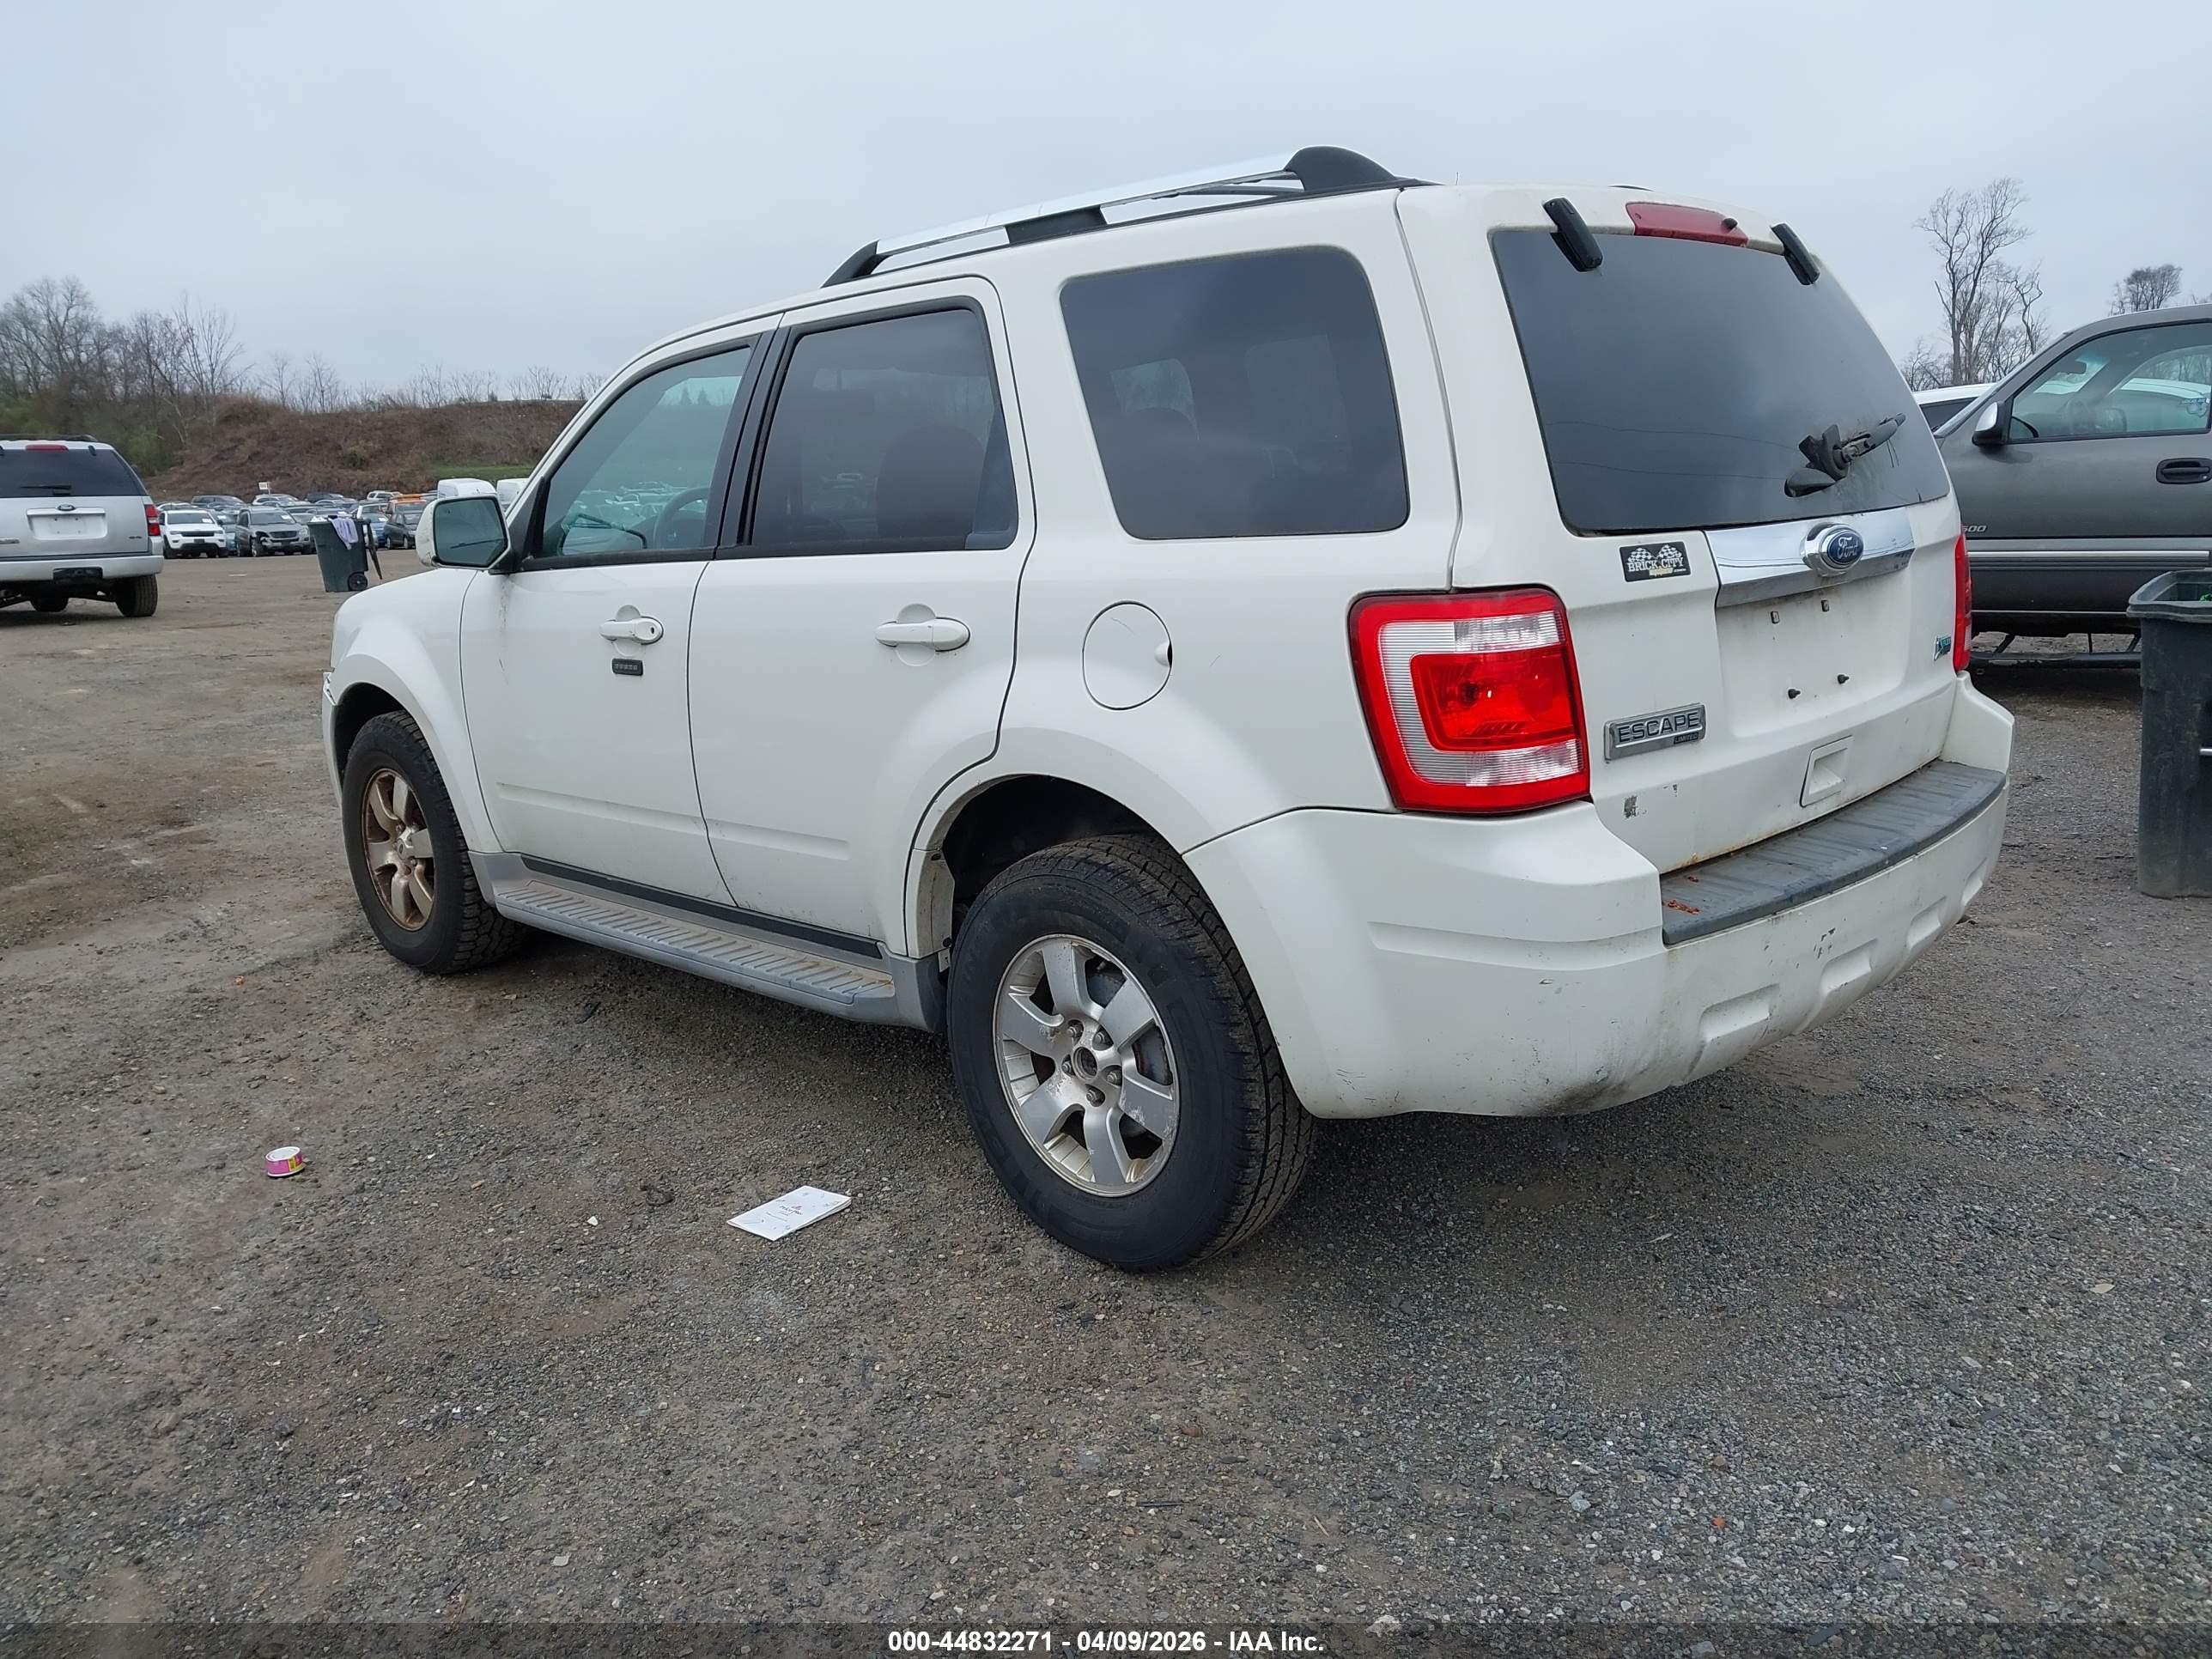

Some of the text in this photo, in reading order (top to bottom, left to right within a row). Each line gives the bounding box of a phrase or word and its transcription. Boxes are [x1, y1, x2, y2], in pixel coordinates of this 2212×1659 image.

[1837, 537, 1858, 559] Ford
[1626, 557, 1684, 572] BRICK CITY
[1618, 711, 1700, 743] ESCAPE
